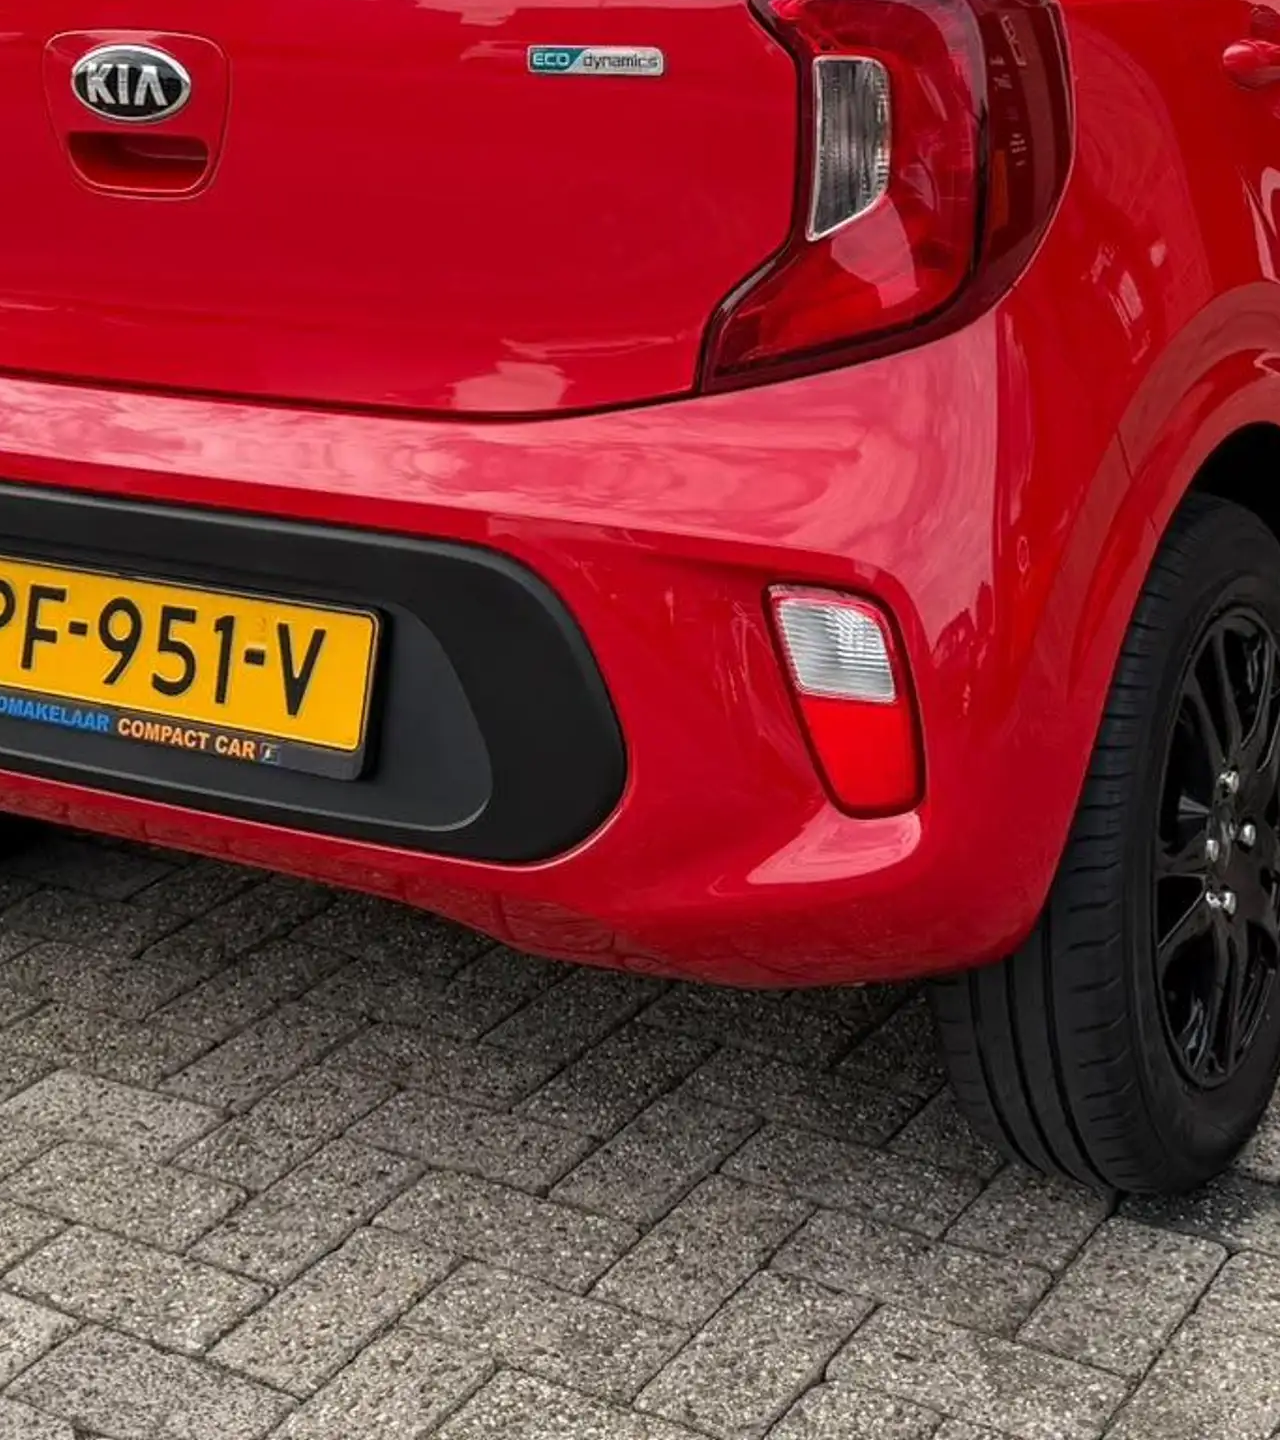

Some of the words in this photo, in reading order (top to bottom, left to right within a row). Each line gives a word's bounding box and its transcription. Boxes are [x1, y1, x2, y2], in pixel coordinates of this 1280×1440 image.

[583, 53, 658, 70] dynamics
[85, 63, 169, 108] KIA
[118, 717, 211, 749] COMPACT
[215, 736, 256, 760] CAR
